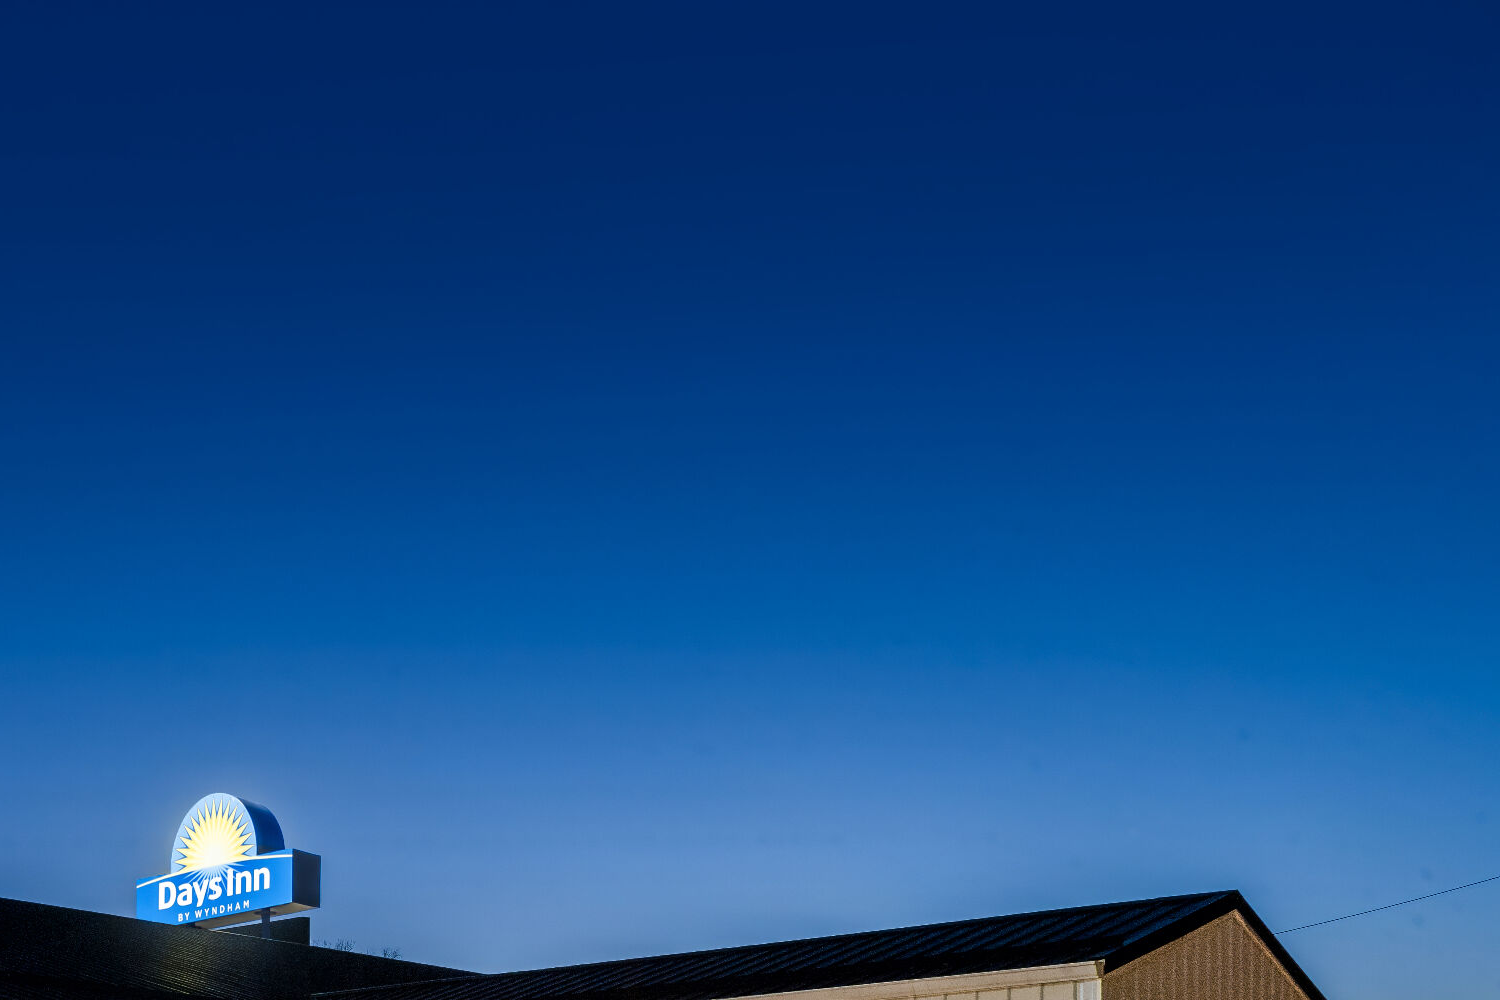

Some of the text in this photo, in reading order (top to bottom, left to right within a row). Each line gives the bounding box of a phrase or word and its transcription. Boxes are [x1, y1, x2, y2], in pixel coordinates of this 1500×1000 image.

[158, 867, 271, 910] Days Inn
[177, 899, 250, 922] BY WYNDHAM
